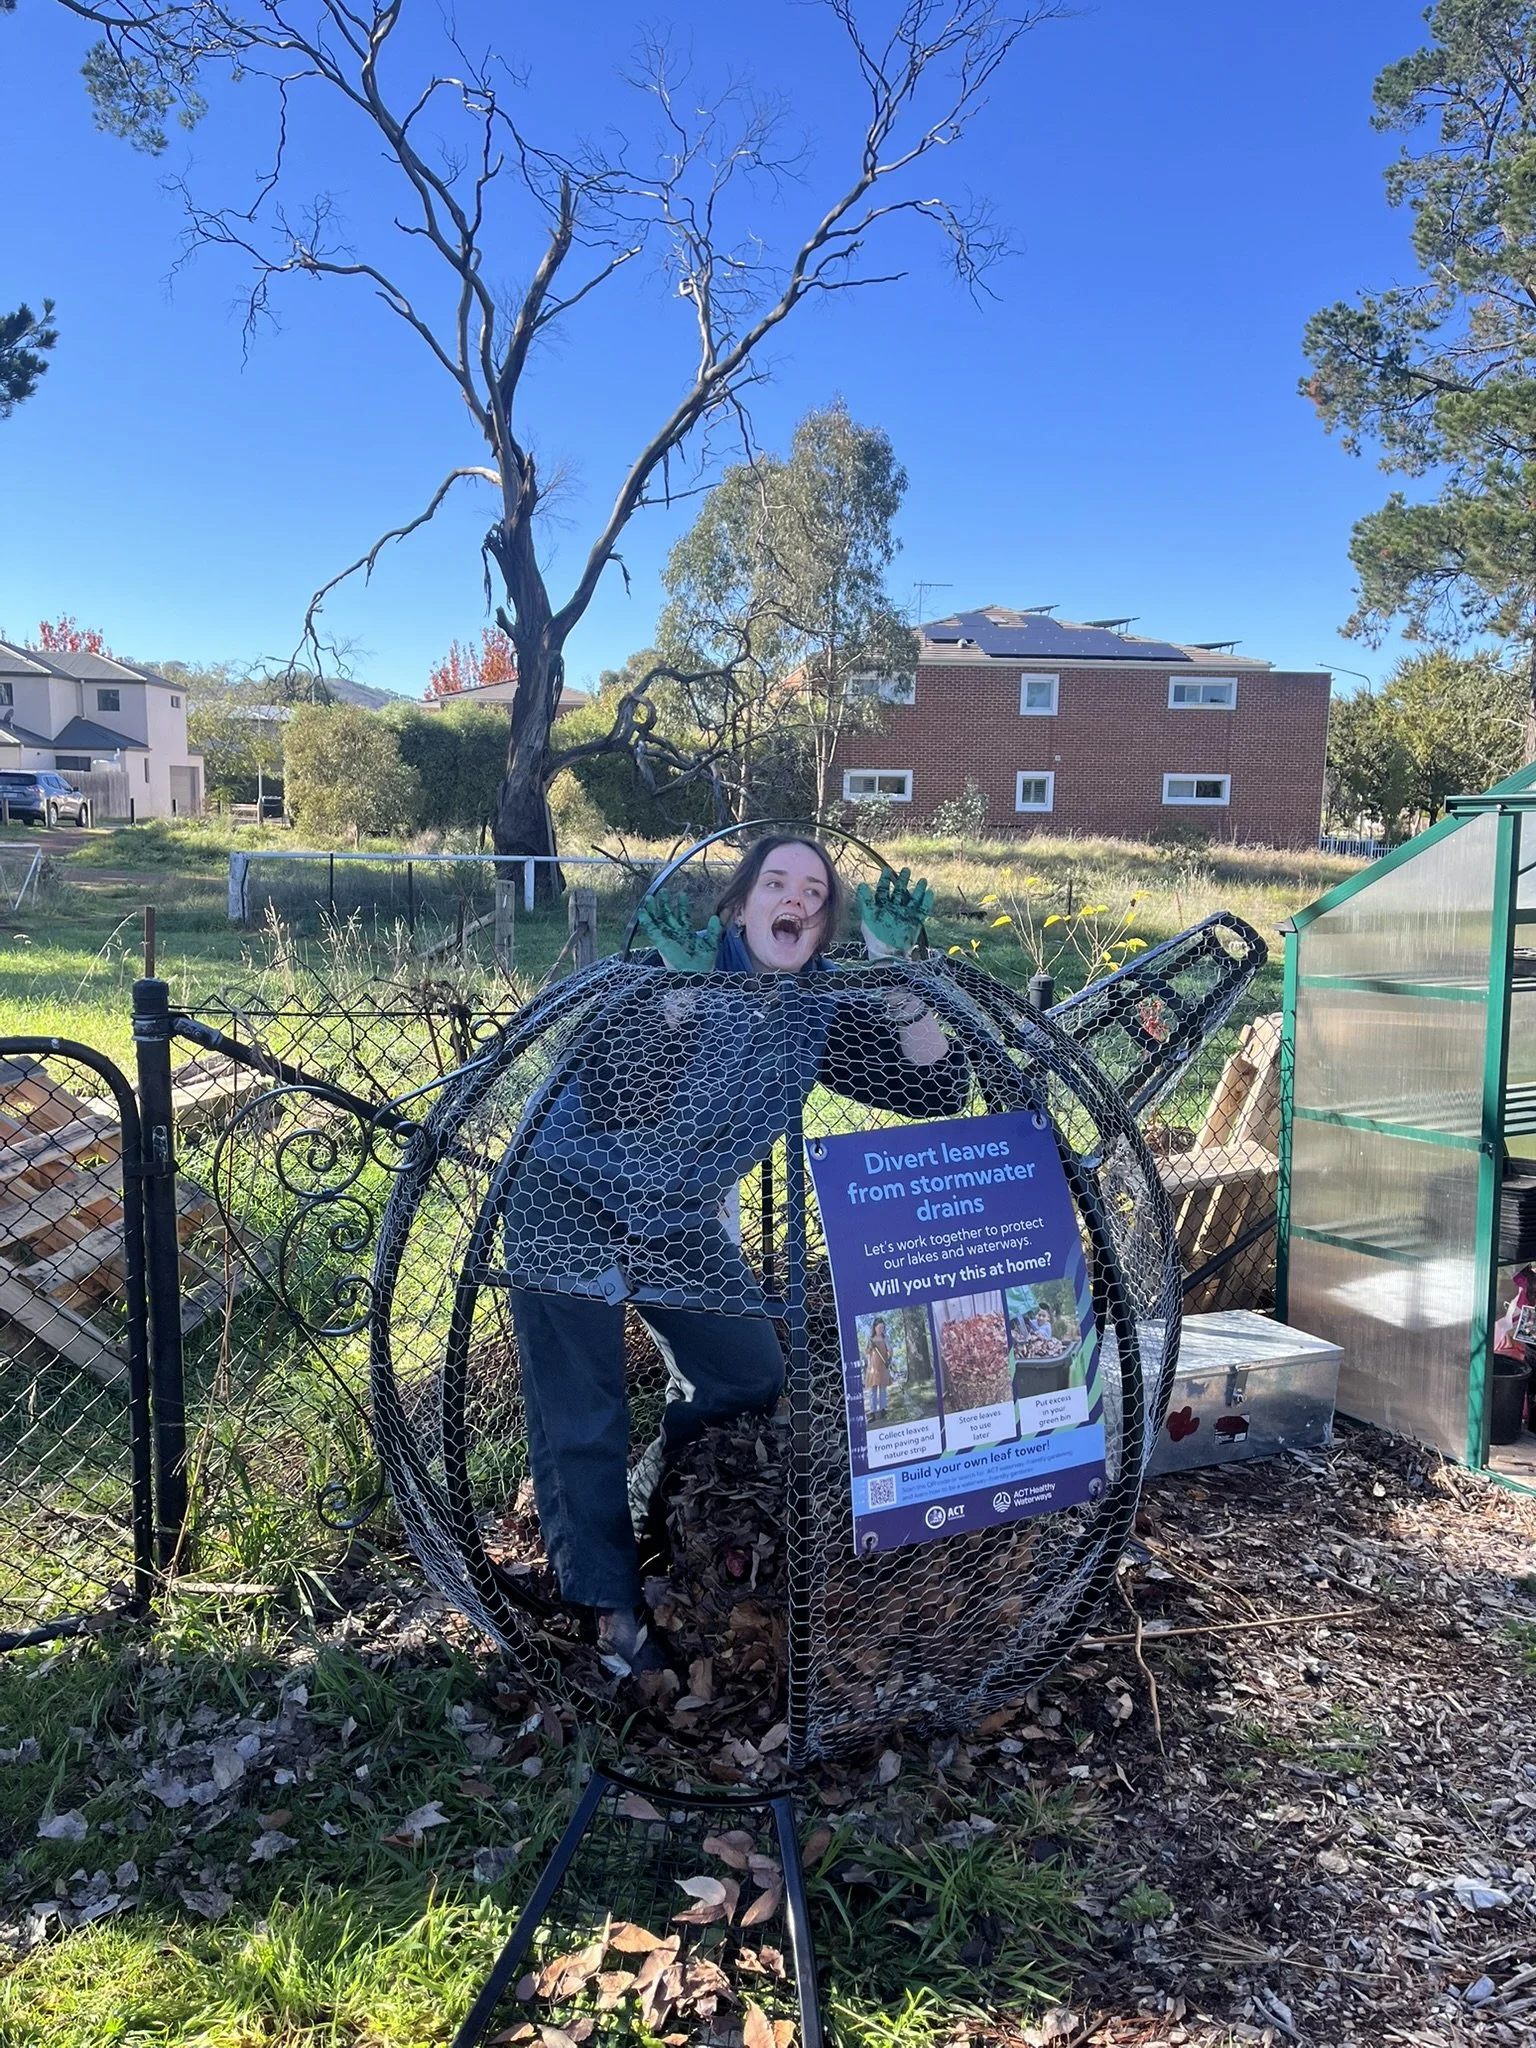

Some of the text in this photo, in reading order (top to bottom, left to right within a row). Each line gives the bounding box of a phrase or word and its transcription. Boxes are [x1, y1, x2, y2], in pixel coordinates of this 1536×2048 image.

[864, 1139, 1010, 1175] Divert leaves
[848, 1162, 1035, 1205] from stormwater
[917, 1195, 984, 1222] drains
[864, 1217, 1044, 1257] Let's work together to protect
[884, 1237, 1032, 1271] our lakes and waterways.
[870, 1252, 1052, 1297] Will you try this at home?
[1050, 1395, 1071, 1404] excess
[959, 1410, 1000, 1424] Store leaves
[1051, 1406, 1065, 1415] your
[1039, 1417, 1058, 1427] green
[879, 1426, 929, 1440] Collect leaves
[973, 1432, 989, 1440] later
[875, 1444, 892, 1452] from
[895, 1438, 919, 1449] paving
[884, 1446, 926, 1460] nature strip
[902, 1440, 1050, 1483] Build your own leaf tower!
[1014, 1483, 1055, 1498] ACT Healthy
[1014, 1492, 1052, 1507] Waterways
[948, 1505, 964, 1517] ACT
